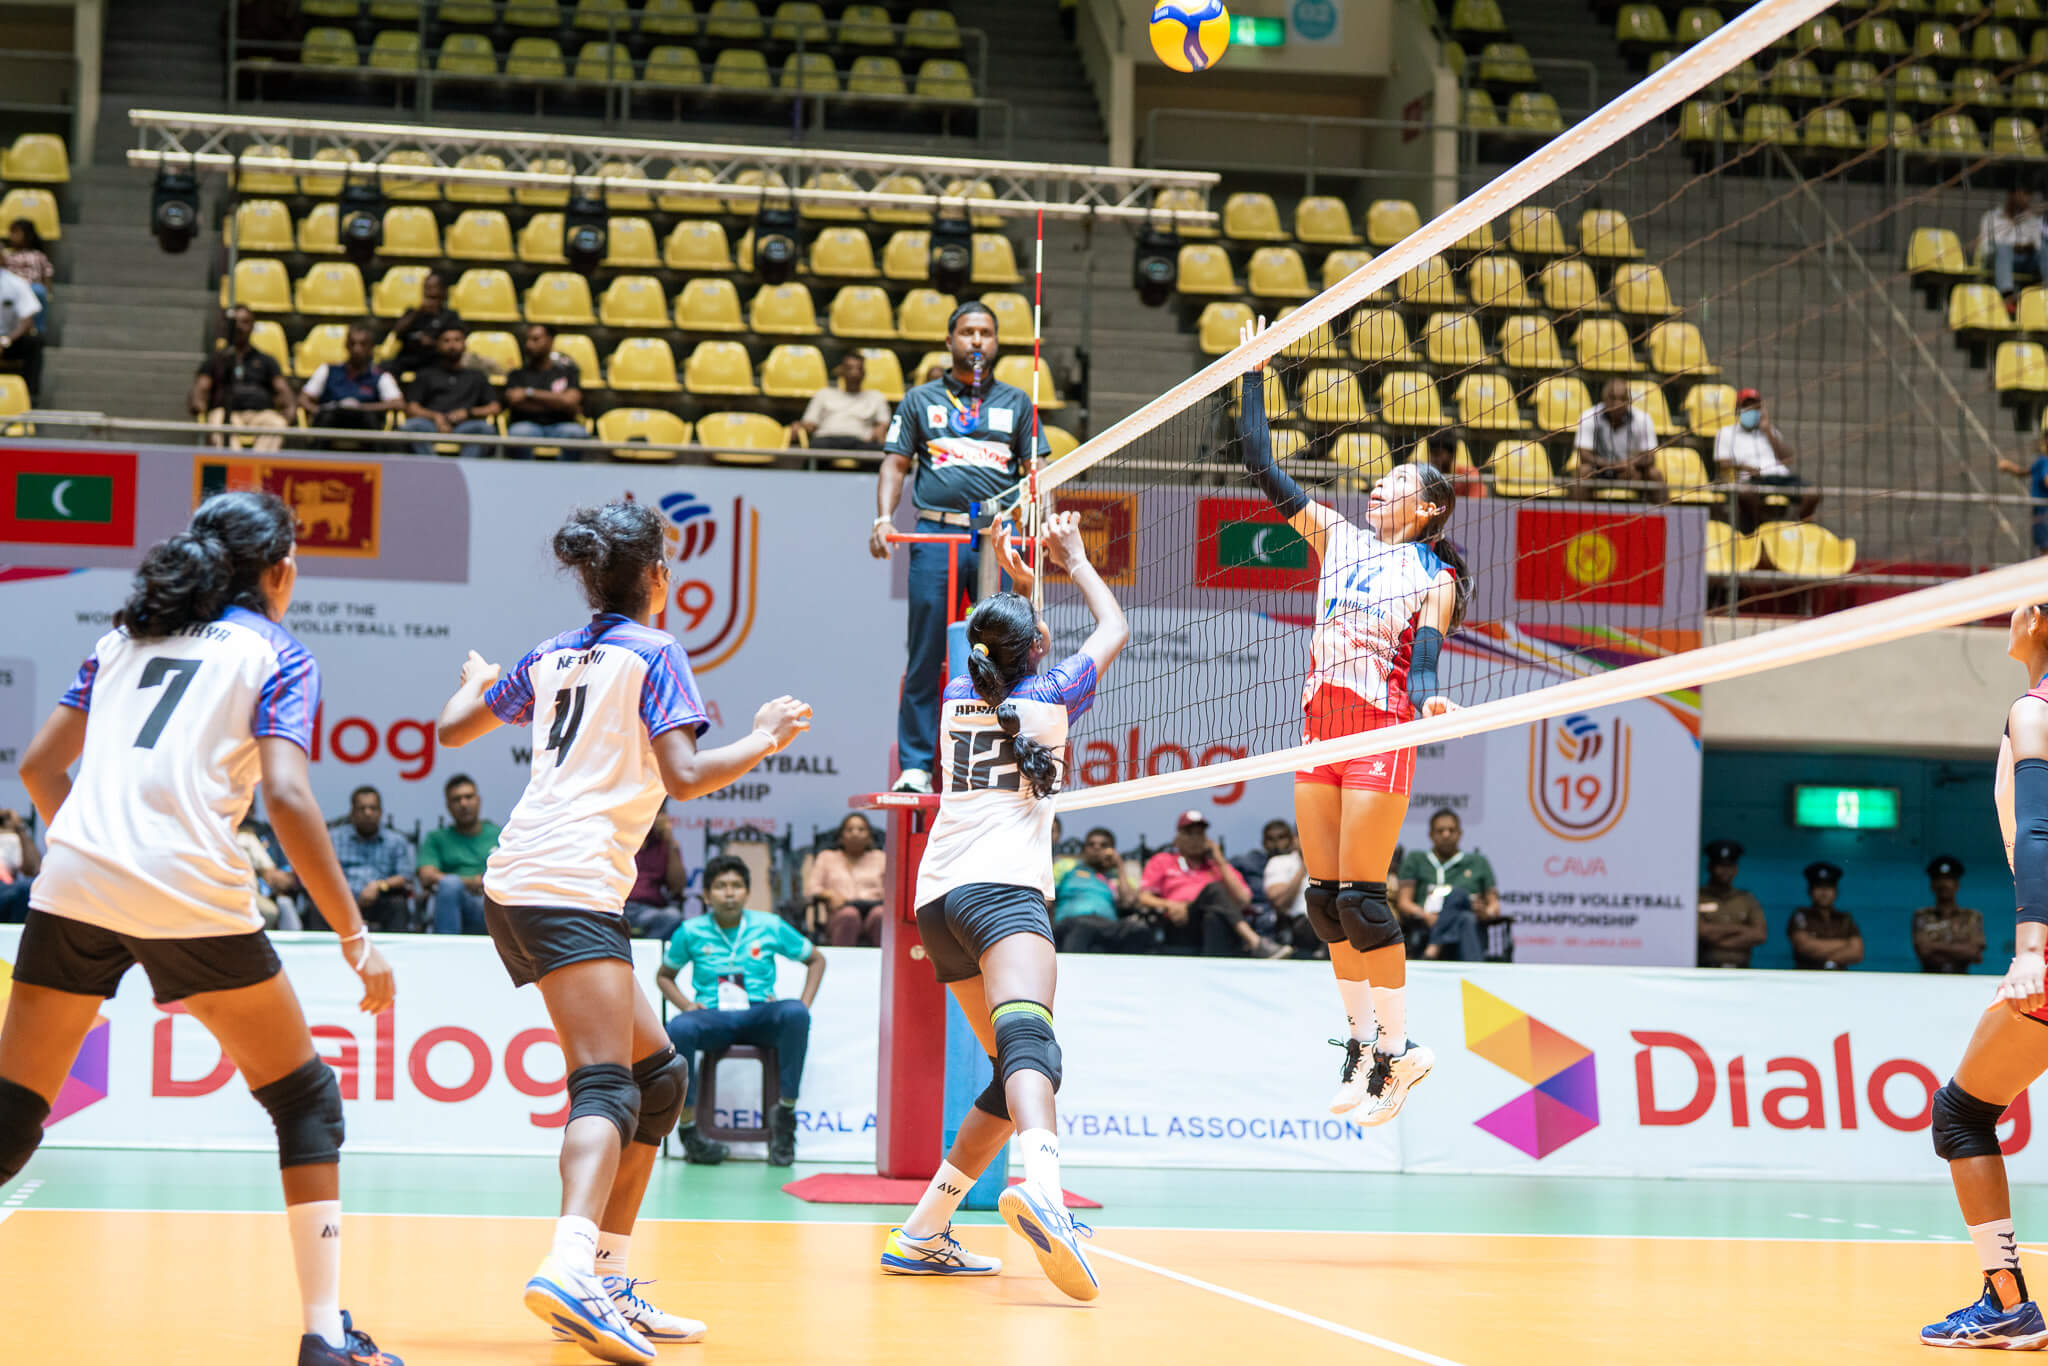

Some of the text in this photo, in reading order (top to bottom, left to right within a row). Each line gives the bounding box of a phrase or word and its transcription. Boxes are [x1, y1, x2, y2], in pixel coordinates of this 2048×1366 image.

[1344, 564, 1383, 594] 12
[346, 603, 376, 617] THE
[290, 621, 450, 638] VOLLEYBALL TEAM
[134, 656, 202, 749] 7
[545, 684, 588, 768] 4
[949, 730, 1022, 792] 12
[1555, 774, 1602, 811] 19
[1544, 855, 1608, 878] CAVA
[1579, 893, 1685, 910] VOLLEYBALL
[1167, 1115, 1364, 1141] ASSOCIATION
